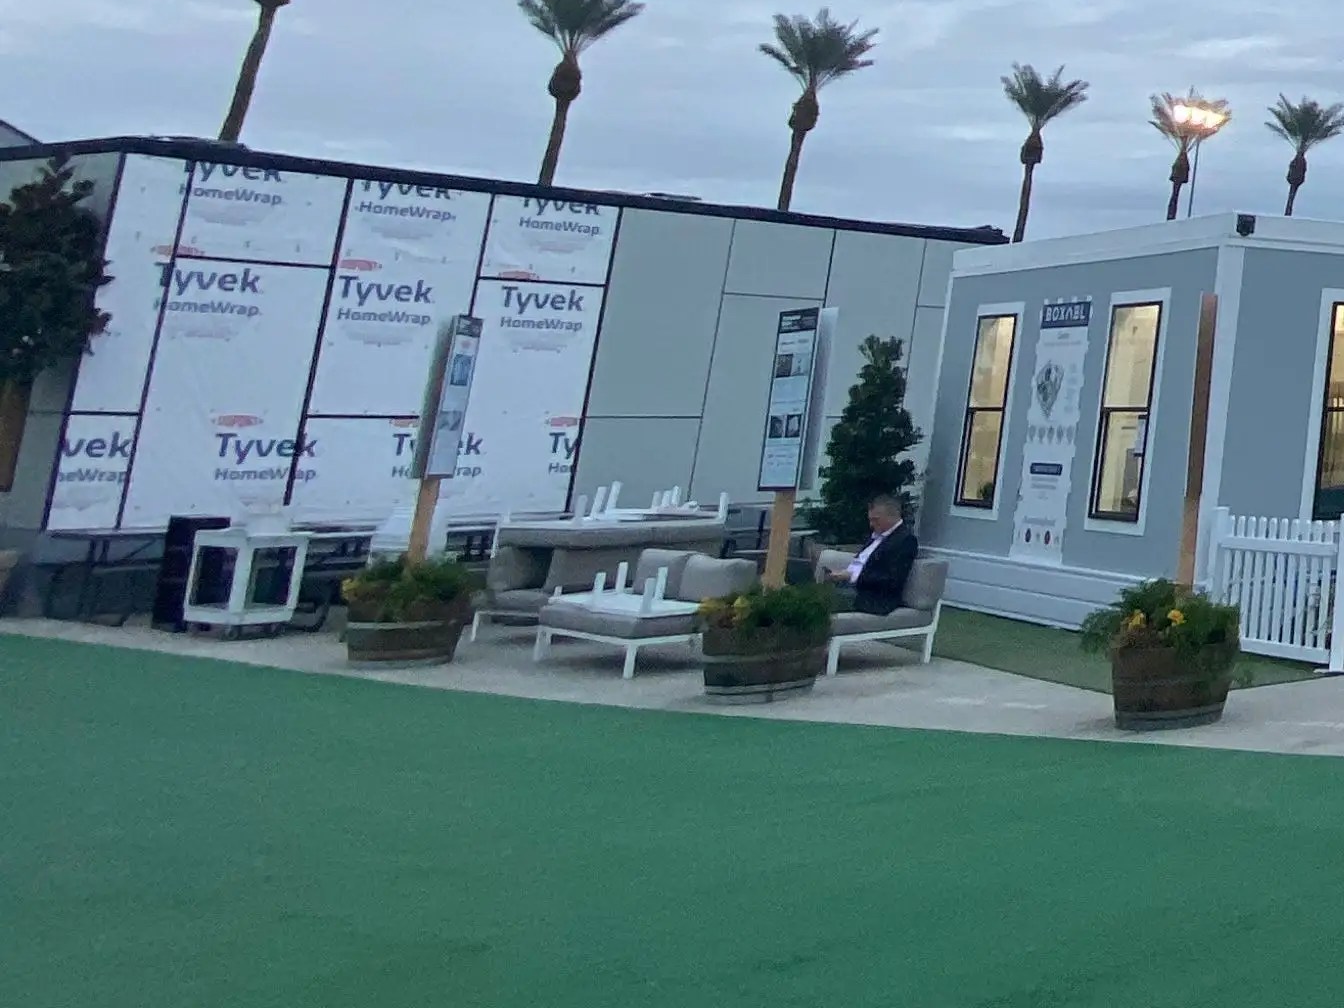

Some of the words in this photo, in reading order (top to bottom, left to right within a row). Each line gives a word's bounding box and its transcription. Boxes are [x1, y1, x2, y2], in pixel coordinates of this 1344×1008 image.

[359, 201, 451, 223] HomeWrap
[518, 216, 601, 236] HomeWrap
[154, 261, 261, 296] Tyvek
[338, 274, 434, 307] Tyvek
[501, 285, 585, 315] Tyvek
[337, 307, 431, 326] HomeWrap
[500, 315, 583, 332] HomeWrap
[62, 431, 132, 460] vek
[213, 467, 317, 483] HomeWap
